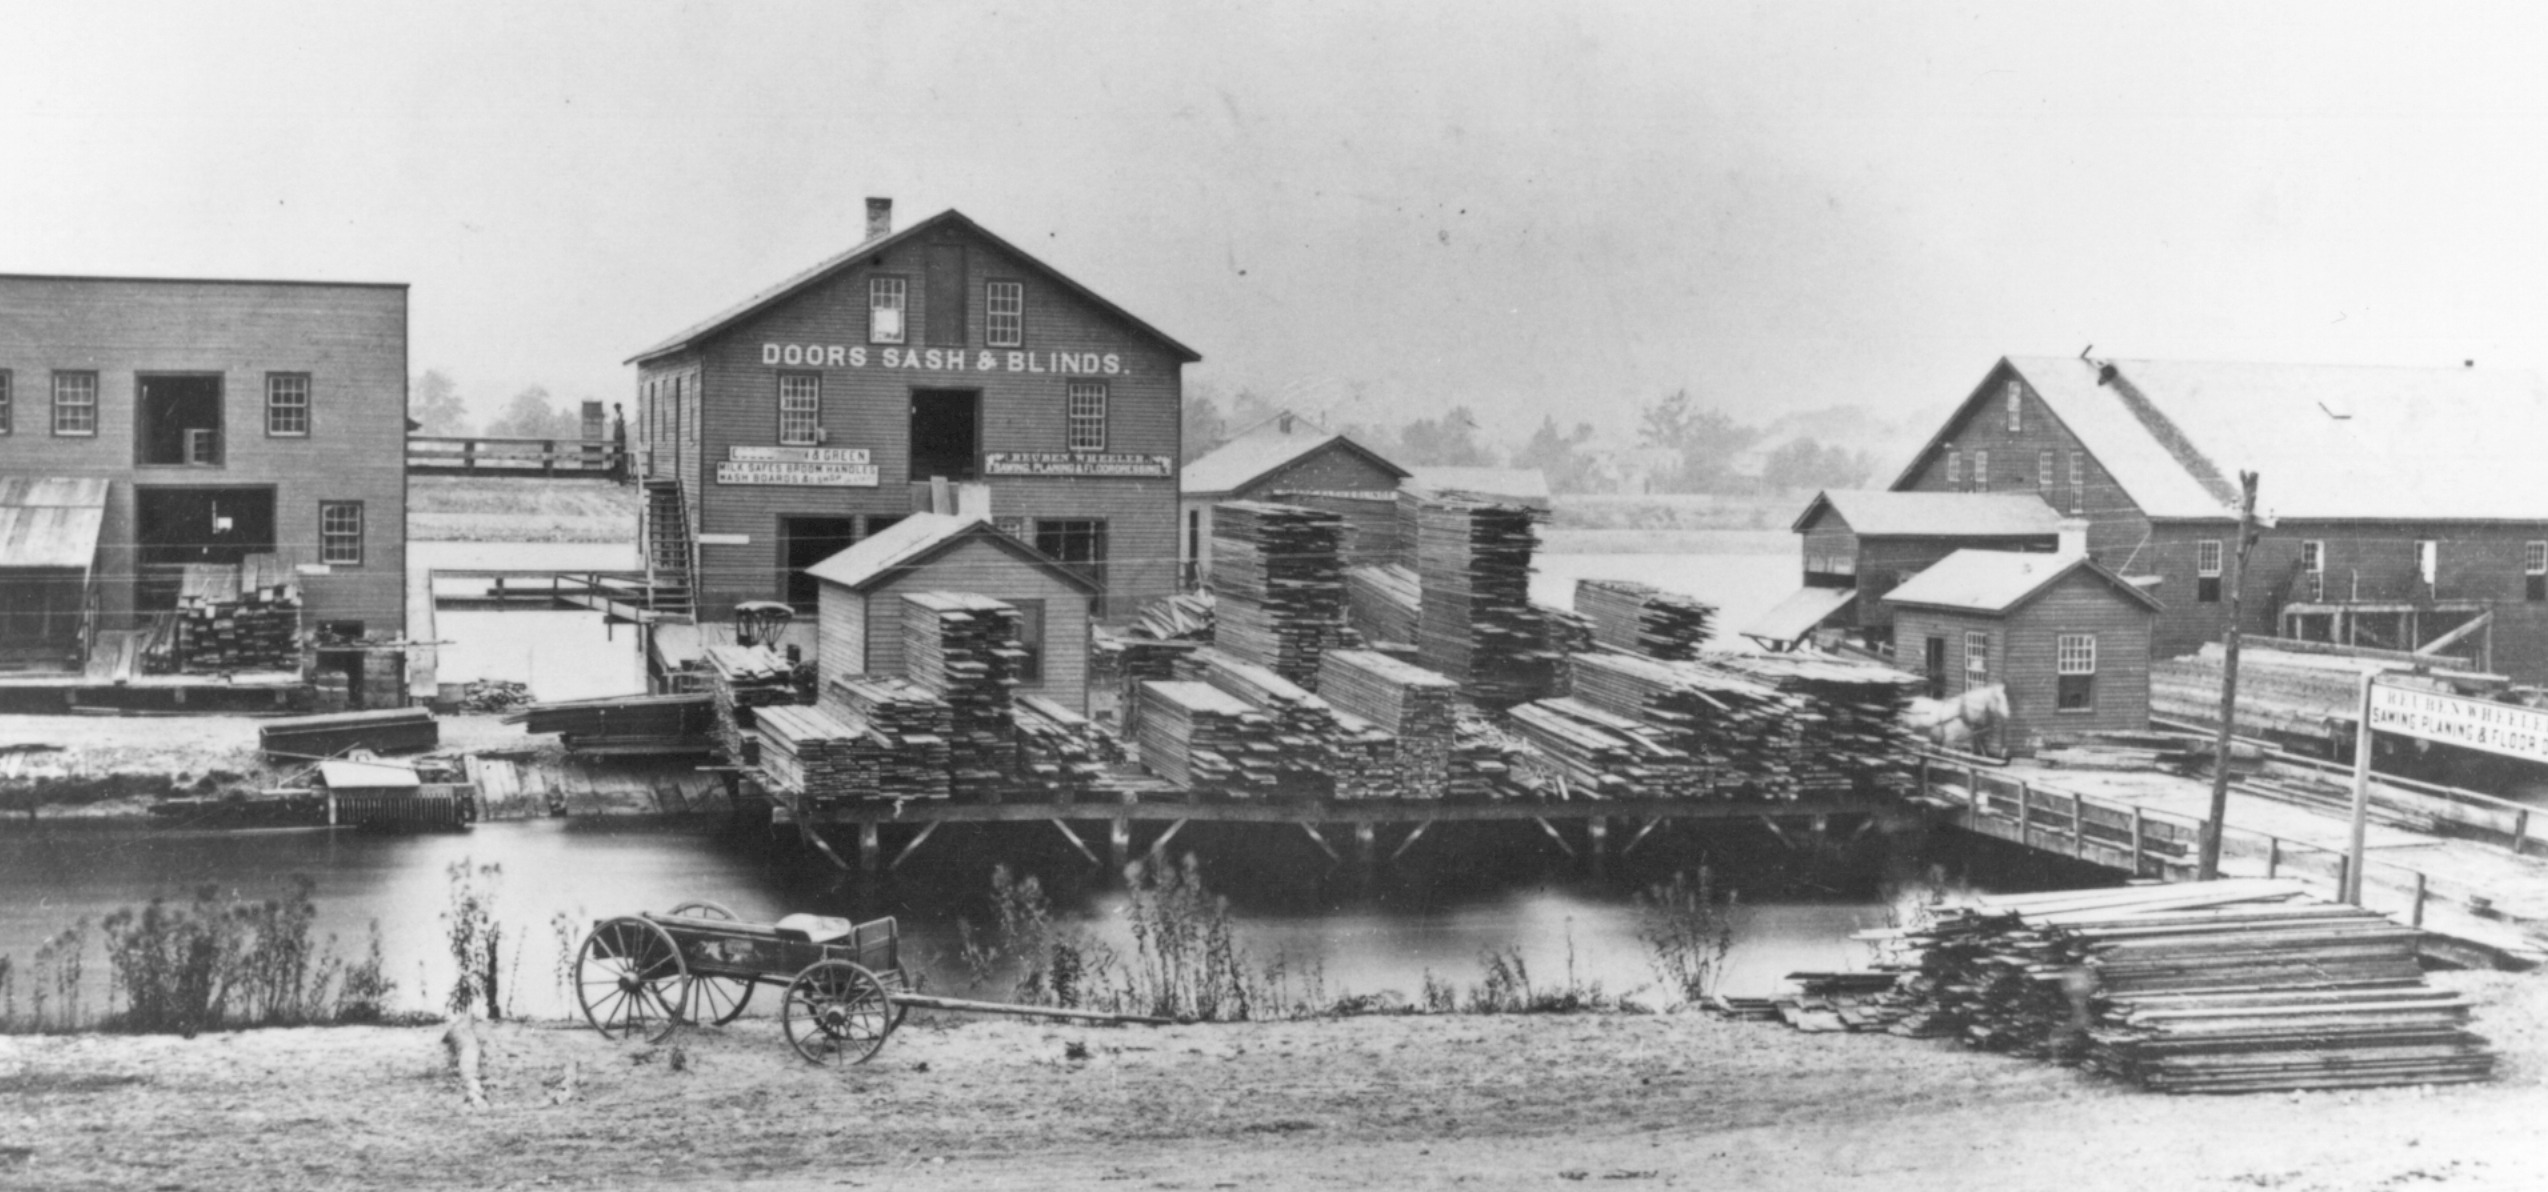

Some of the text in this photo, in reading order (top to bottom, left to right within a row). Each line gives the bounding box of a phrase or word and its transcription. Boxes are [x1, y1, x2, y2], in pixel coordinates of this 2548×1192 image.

[763, 343, 1130, 375] DOORS SASH & BLINDS.
[824, 450, 865, 461] GREEN
[1011, 452, 1070, 462] REUBEN
[719, 462, 876, 475] MILK SAFES BROOM HANDLES
[719, 473, 749, 482] WASH
[753, 473, 798, 484] BOARDS
[2467, 705, 2548, 734] WHEELE
[2372, 706, 2416, 730] SAWING
[2421, 714, 2473, 741] PLANING
[2477, 726, 2487, 744] &
[2491, 729, 2536, 752] FLOOR
